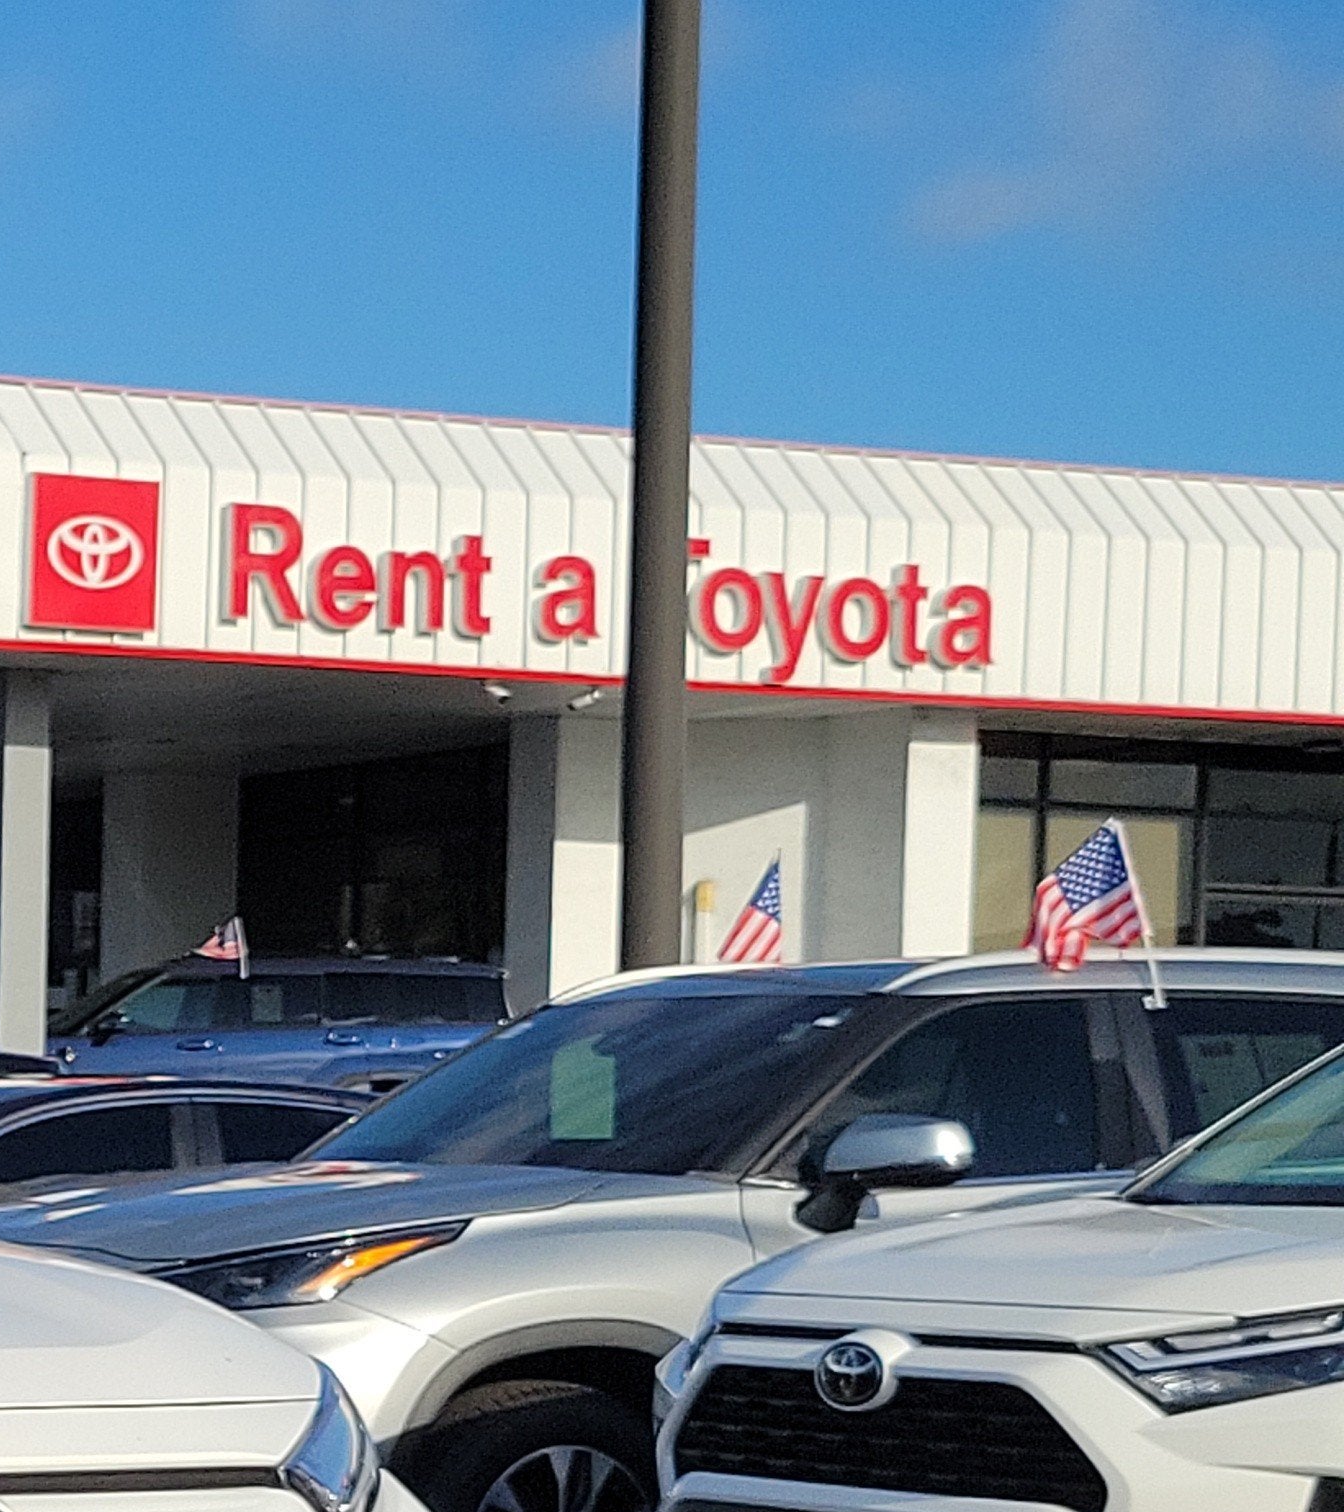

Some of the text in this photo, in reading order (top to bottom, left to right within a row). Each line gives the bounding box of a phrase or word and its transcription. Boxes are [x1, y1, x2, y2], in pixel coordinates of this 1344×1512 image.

[226, 502, 994, 684] Rent a oyota
